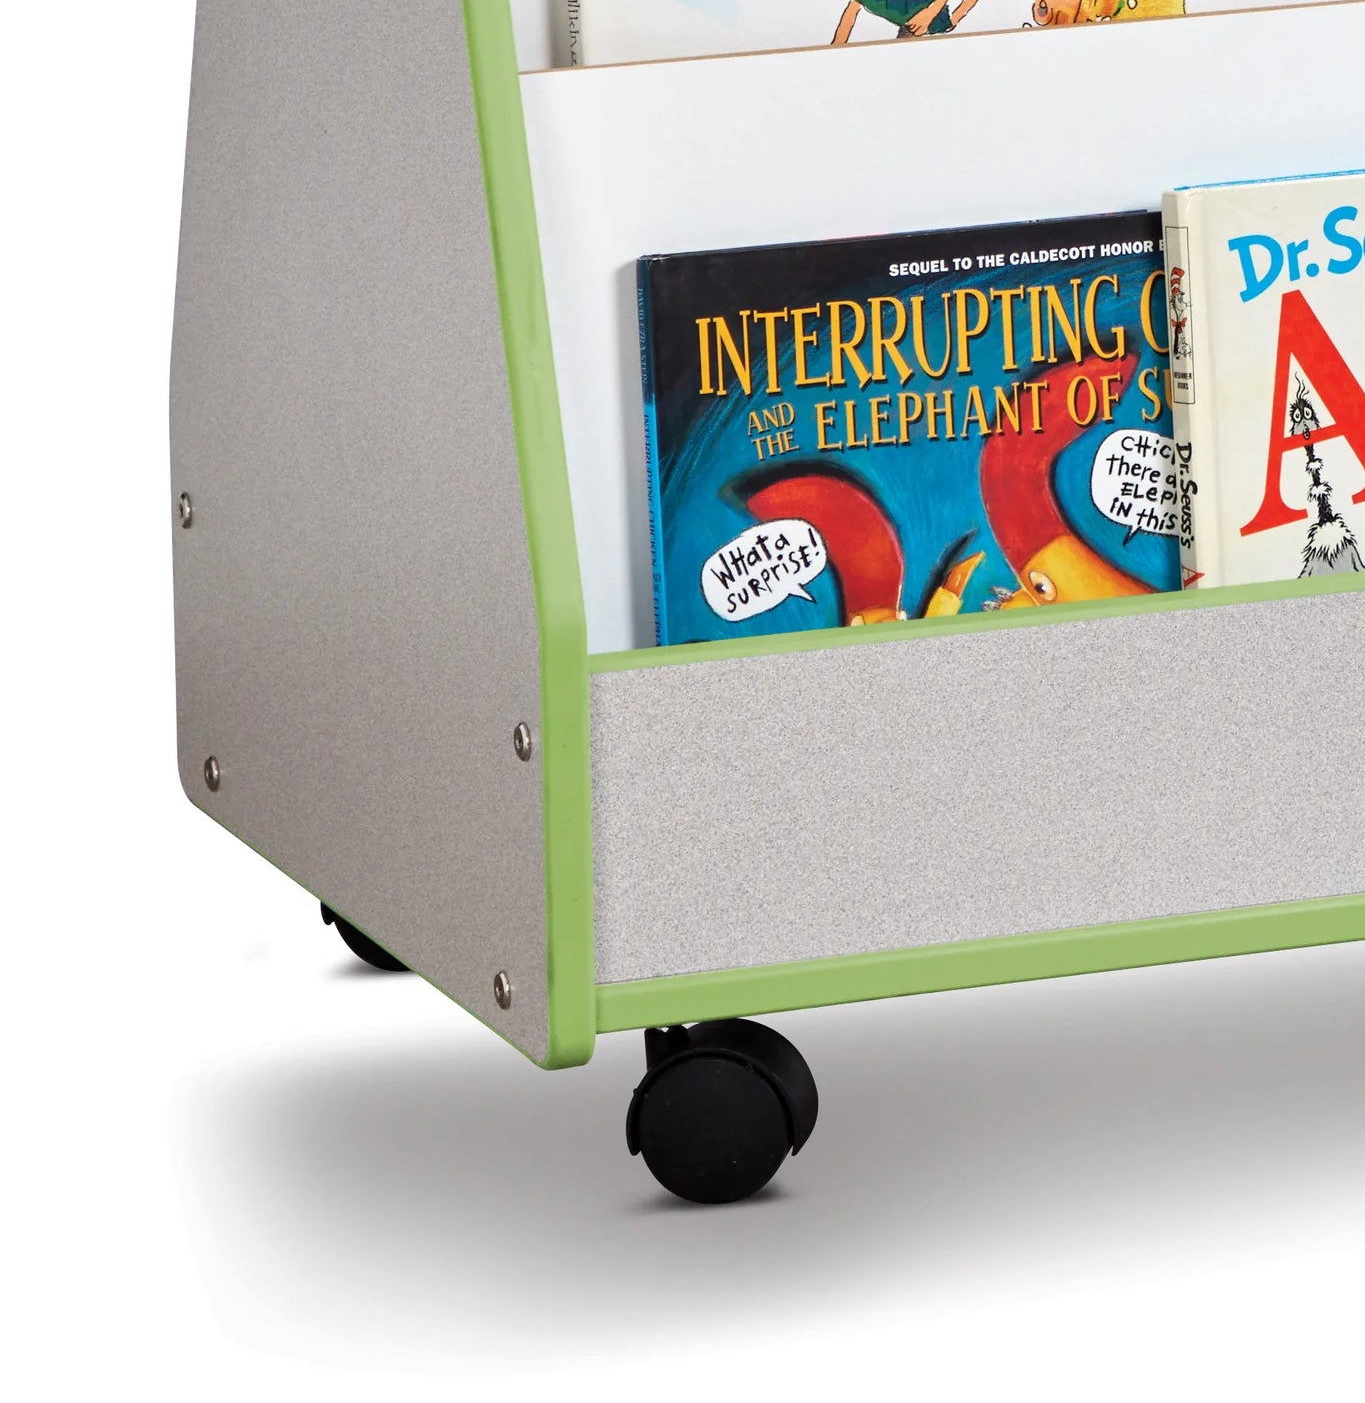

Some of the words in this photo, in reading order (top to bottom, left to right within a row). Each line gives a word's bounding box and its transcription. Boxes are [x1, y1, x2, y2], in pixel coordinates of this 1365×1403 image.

[888, 259, 949, 277] SEQUEL
[952, 256, 972, 271] TO
[976, 253, 1006, 269] THE
[1009, 245, 1096, 266] CALDECOTT
[1100, 240, 1154, 258] HONOR
[1228, 233, 1320, 304] Dr.
[695, 273, 1127, 397] INTERRUPTING
[747, 402, 797, 437] AND
[814, 381, 1050, 452] ELEPHANT
[1066, 368, 1125, 427] OF
[752, 429, 800, 461] THE
[1176, 442, 1192, 476] Dr.
[1106, 453, 1161, 483] there
[1136, 508, 1179, 531] this
[1180, 479, 1198, 549] Seuss's
[775, 534, 791, 550] a
[1182, 565, 1205, 588] A
